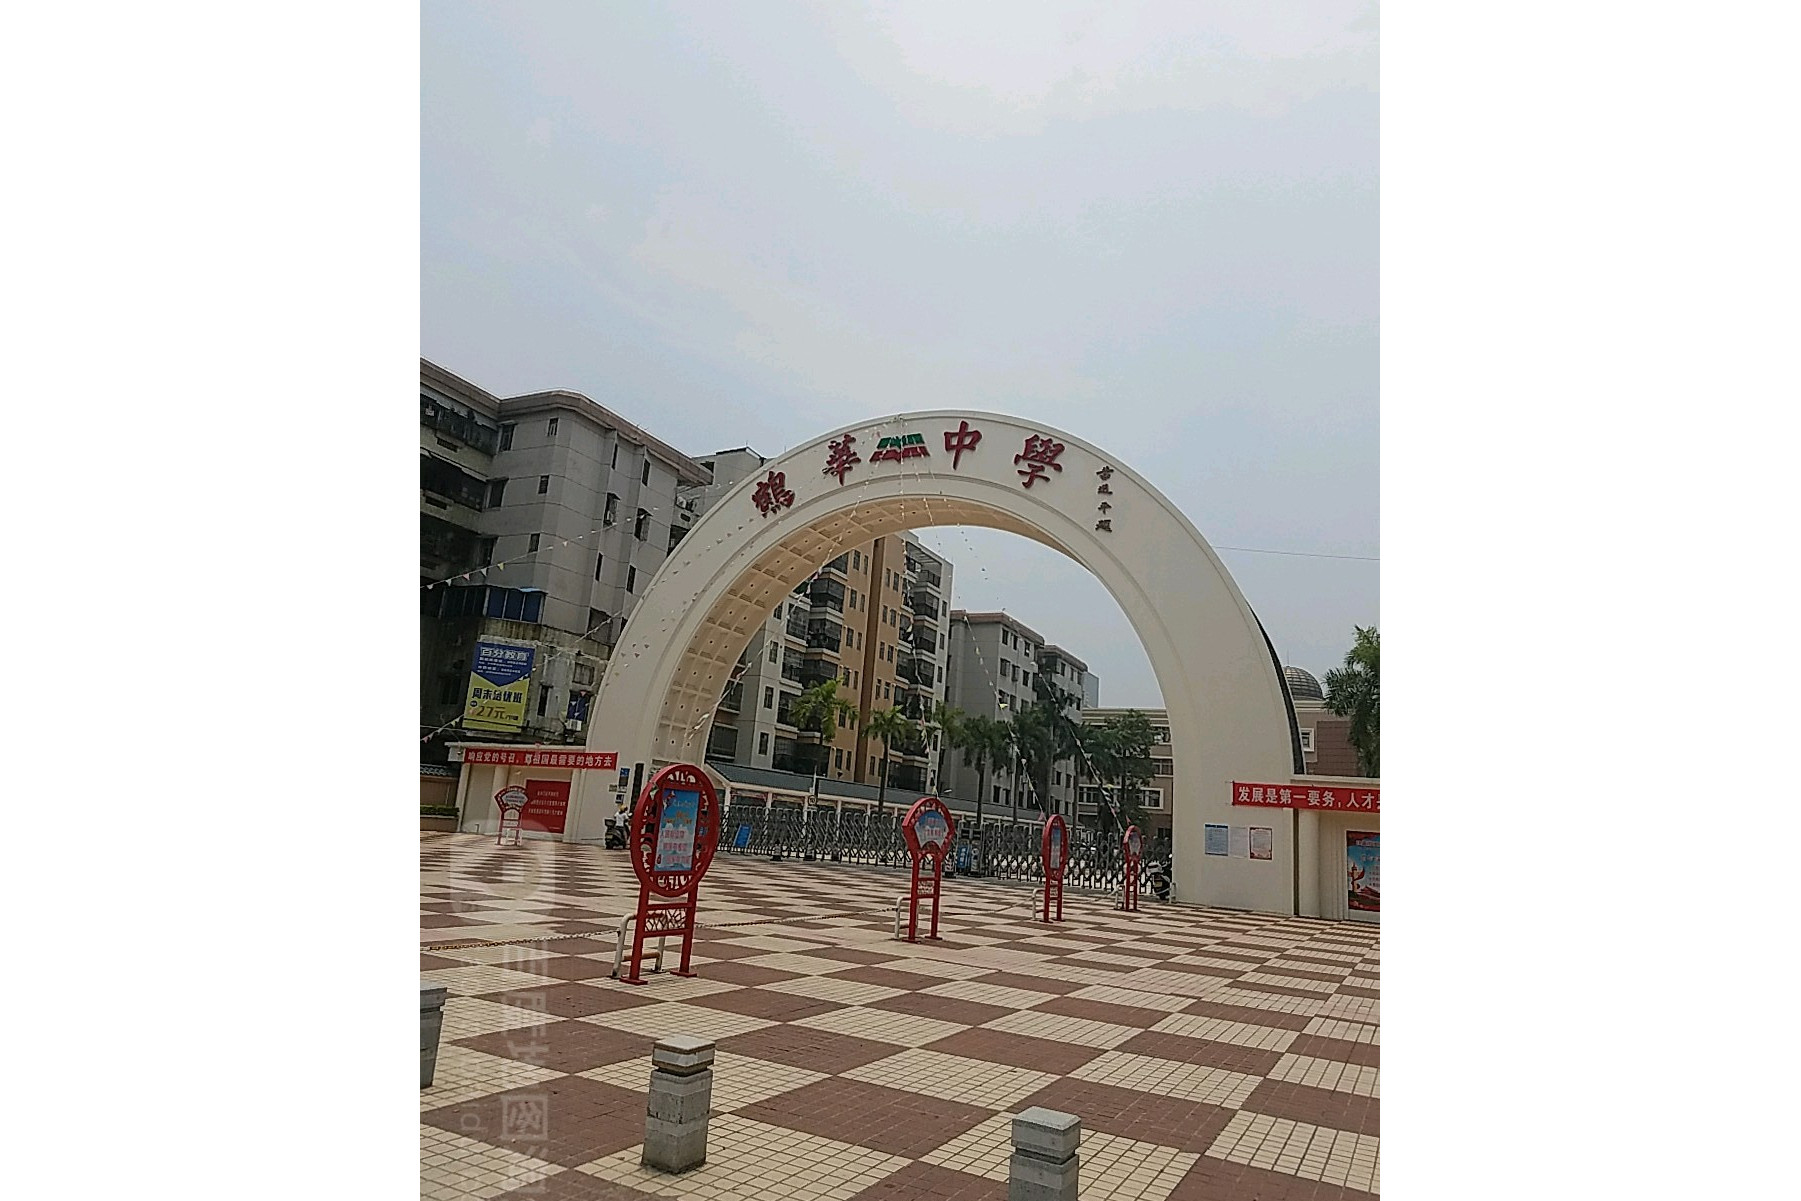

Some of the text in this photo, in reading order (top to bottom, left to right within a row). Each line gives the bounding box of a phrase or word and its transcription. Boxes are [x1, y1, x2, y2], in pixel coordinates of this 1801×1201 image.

[1238, 786, 1380, 810] 发展是第一要务，人才
